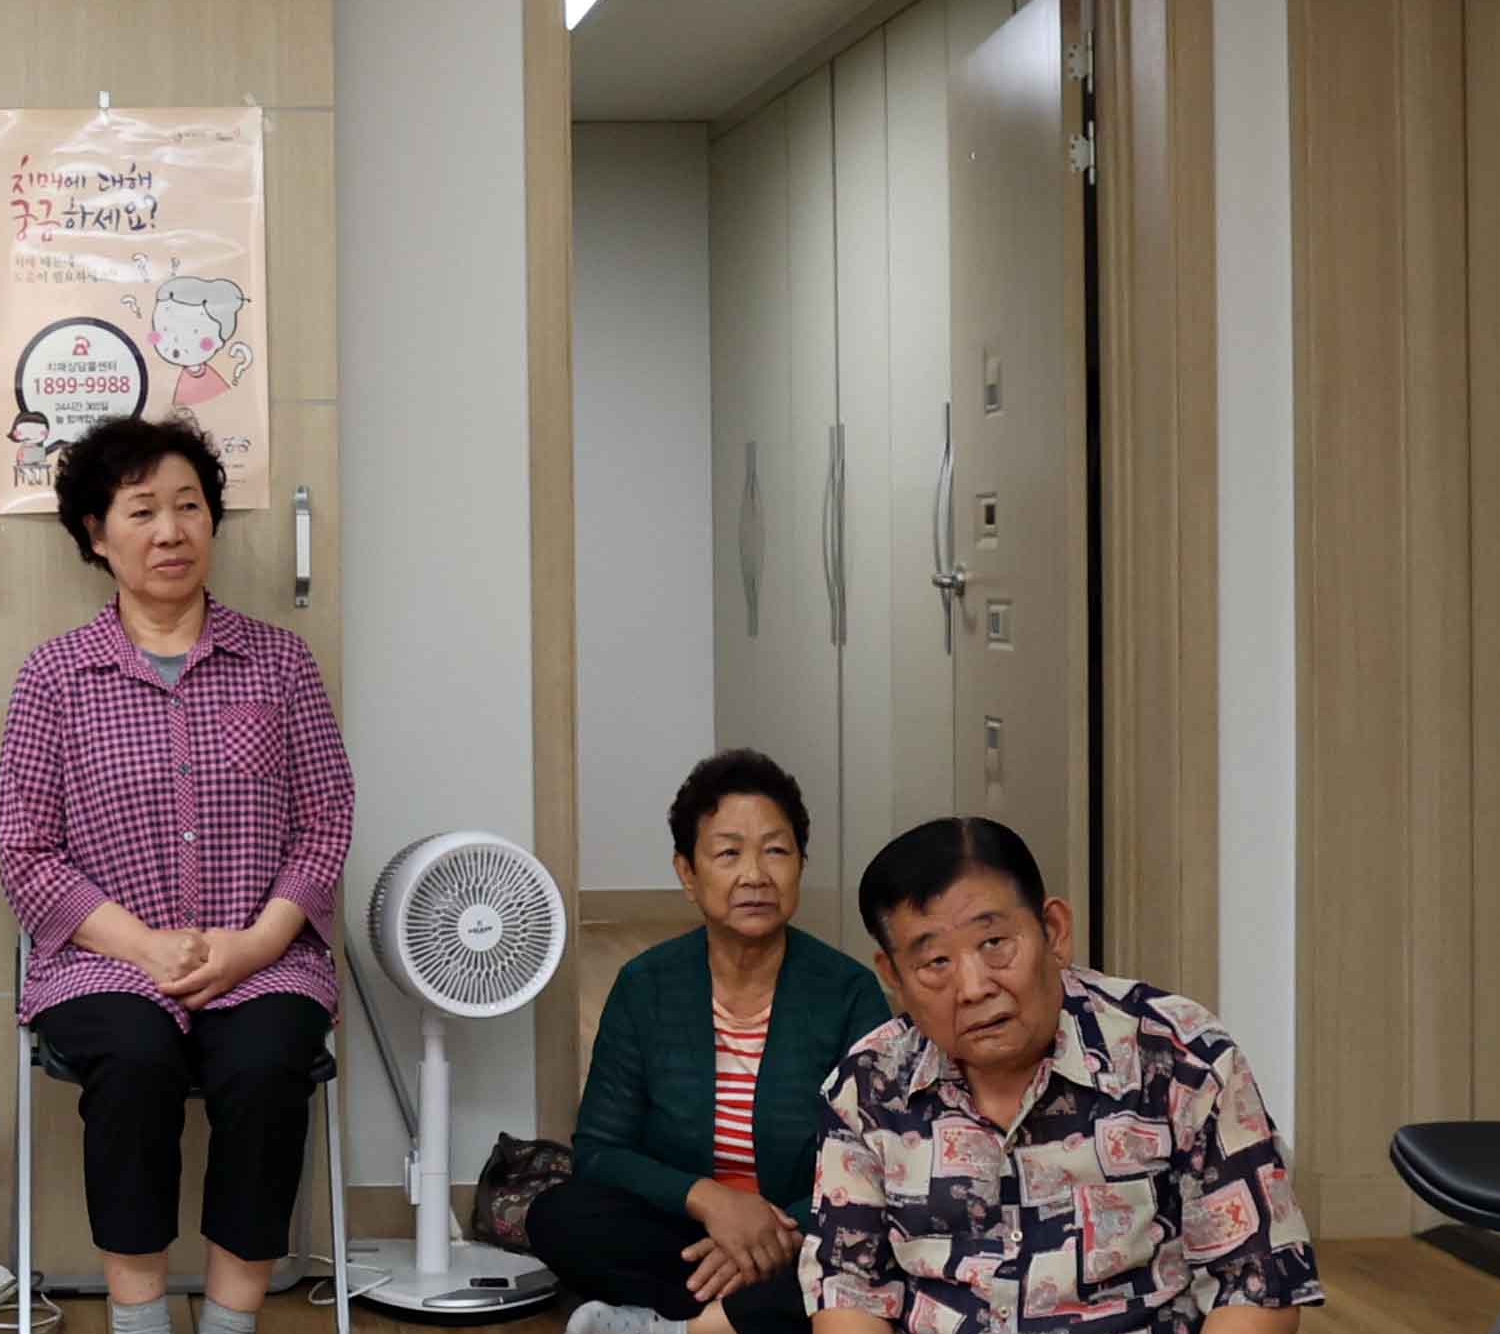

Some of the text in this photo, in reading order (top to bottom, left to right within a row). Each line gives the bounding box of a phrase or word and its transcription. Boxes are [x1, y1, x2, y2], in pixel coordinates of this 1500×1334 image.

[11, 155, 153, 194] 치매에 대해
[10, 195, 158, 242] 궁금하세요?
[33, 376, 131, 395] 1899-9988
